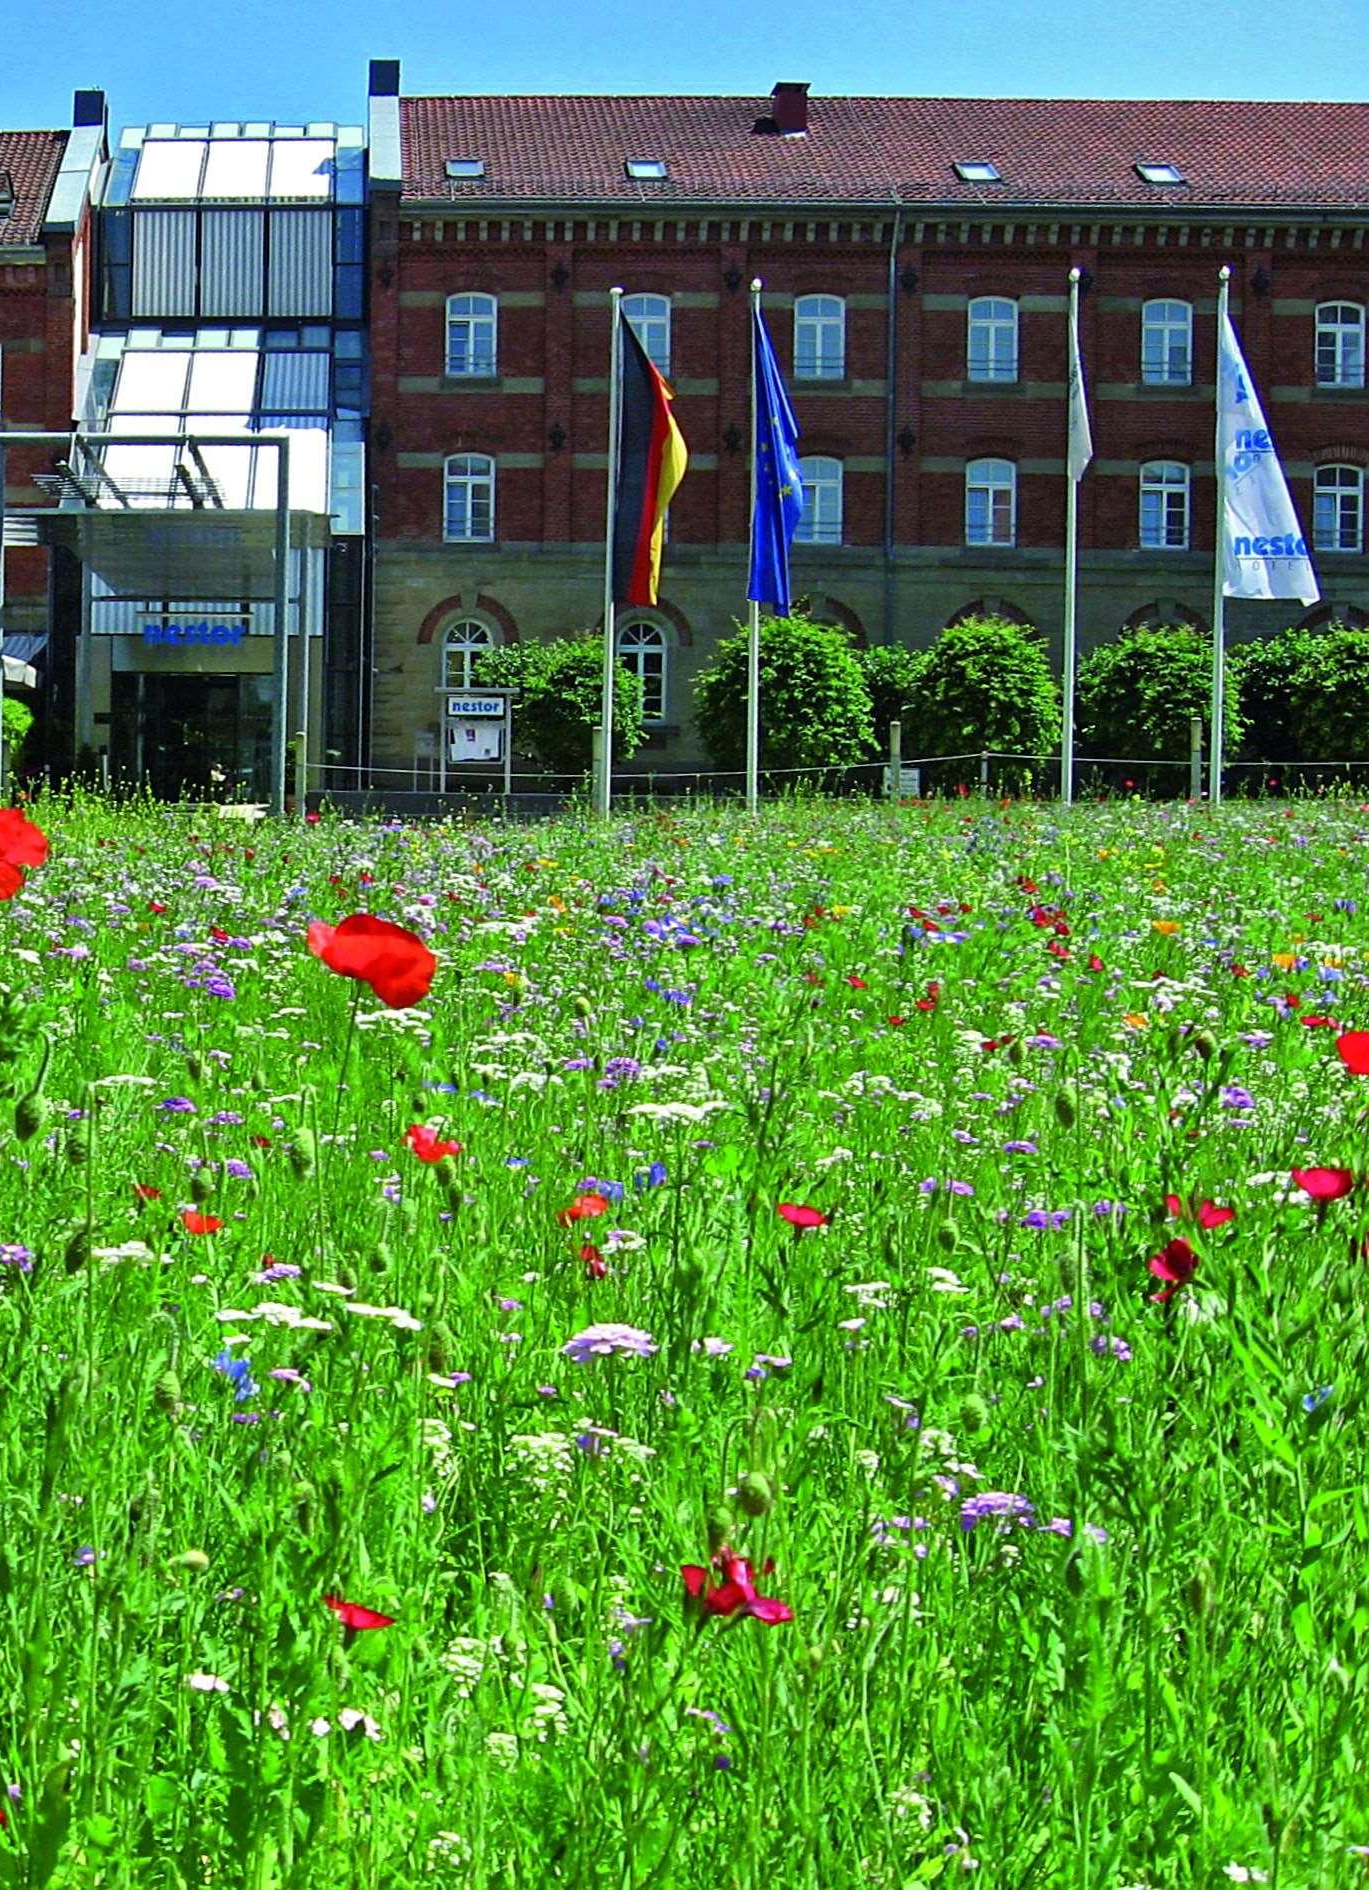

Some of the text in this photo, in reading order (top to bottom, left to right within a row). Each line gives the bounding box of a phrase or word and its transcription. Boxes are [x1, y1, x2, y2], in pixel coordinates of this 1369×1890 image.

[1234, 533, 1307, 555] nesto
[144, 621, 247, 646] nestor
[452, 701, 500, 712] nestor
